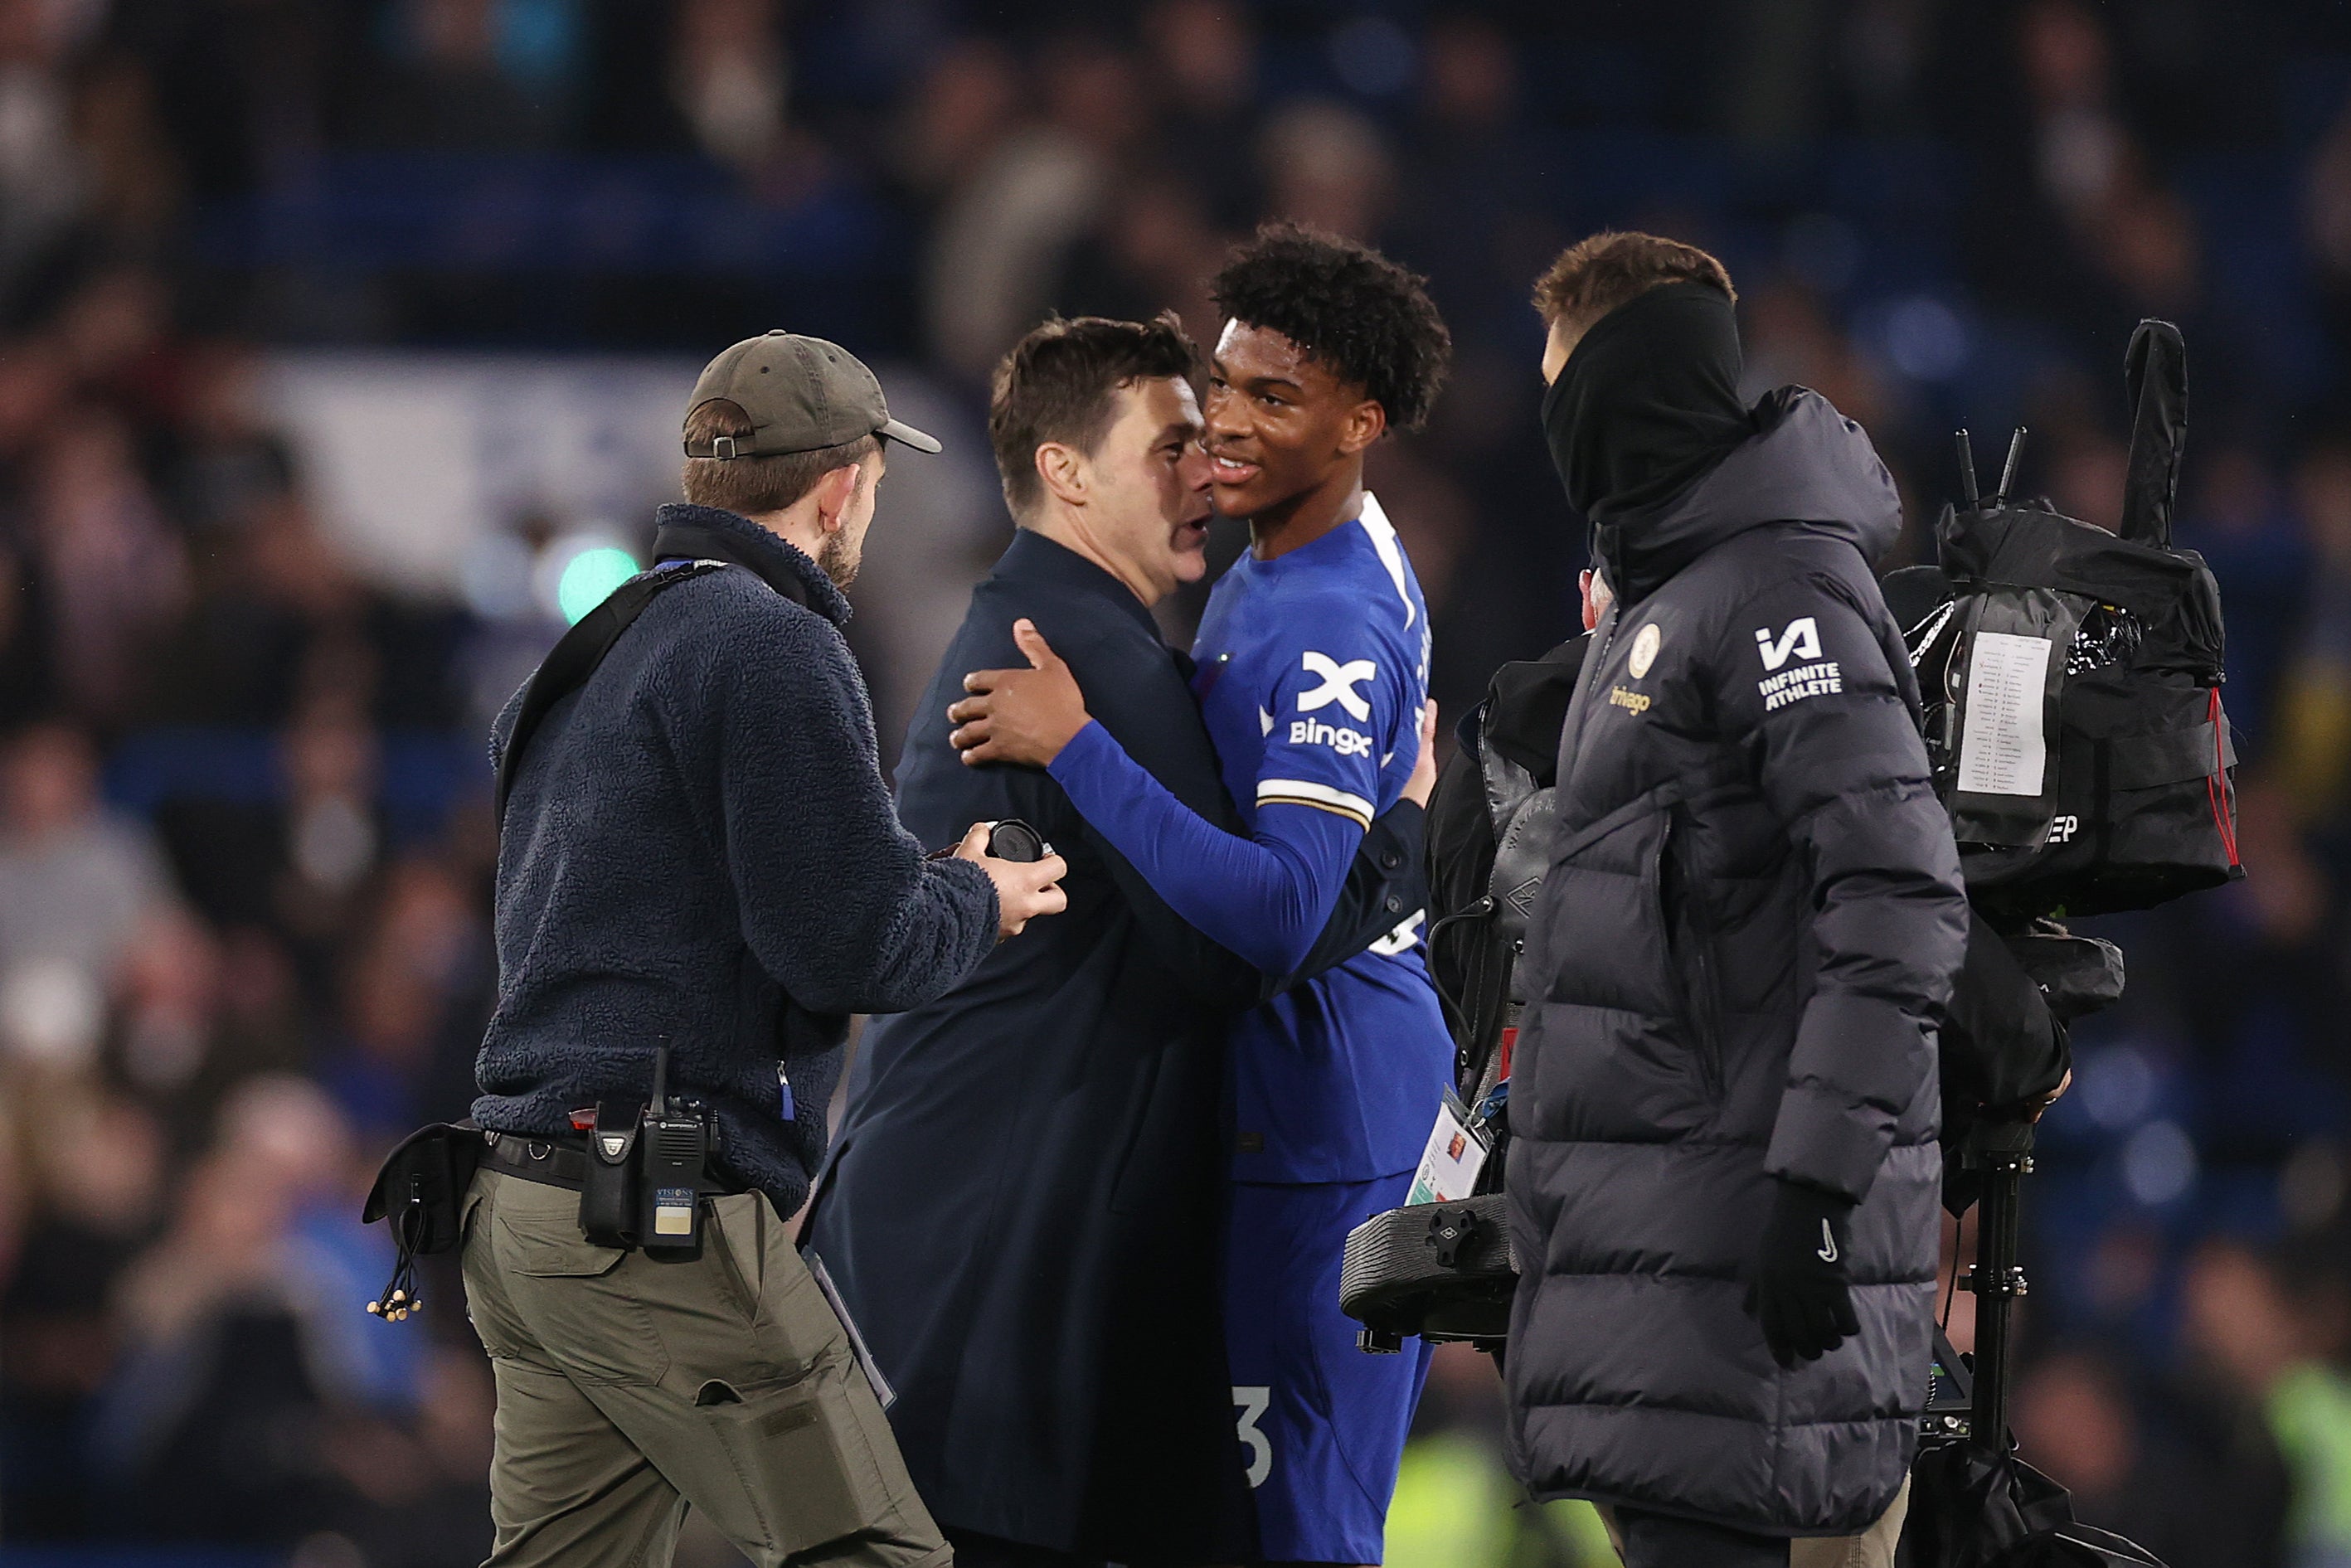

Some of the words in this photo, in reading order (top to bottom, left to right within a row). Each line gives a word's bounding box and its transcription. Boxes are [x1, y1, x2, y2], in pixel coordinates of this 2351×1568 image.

[1758, 662, 1841, 697] INFINITE
[1766, 677, 1843, 711] ATHLETE
[1231, 1386, 1272, 1488] 3
